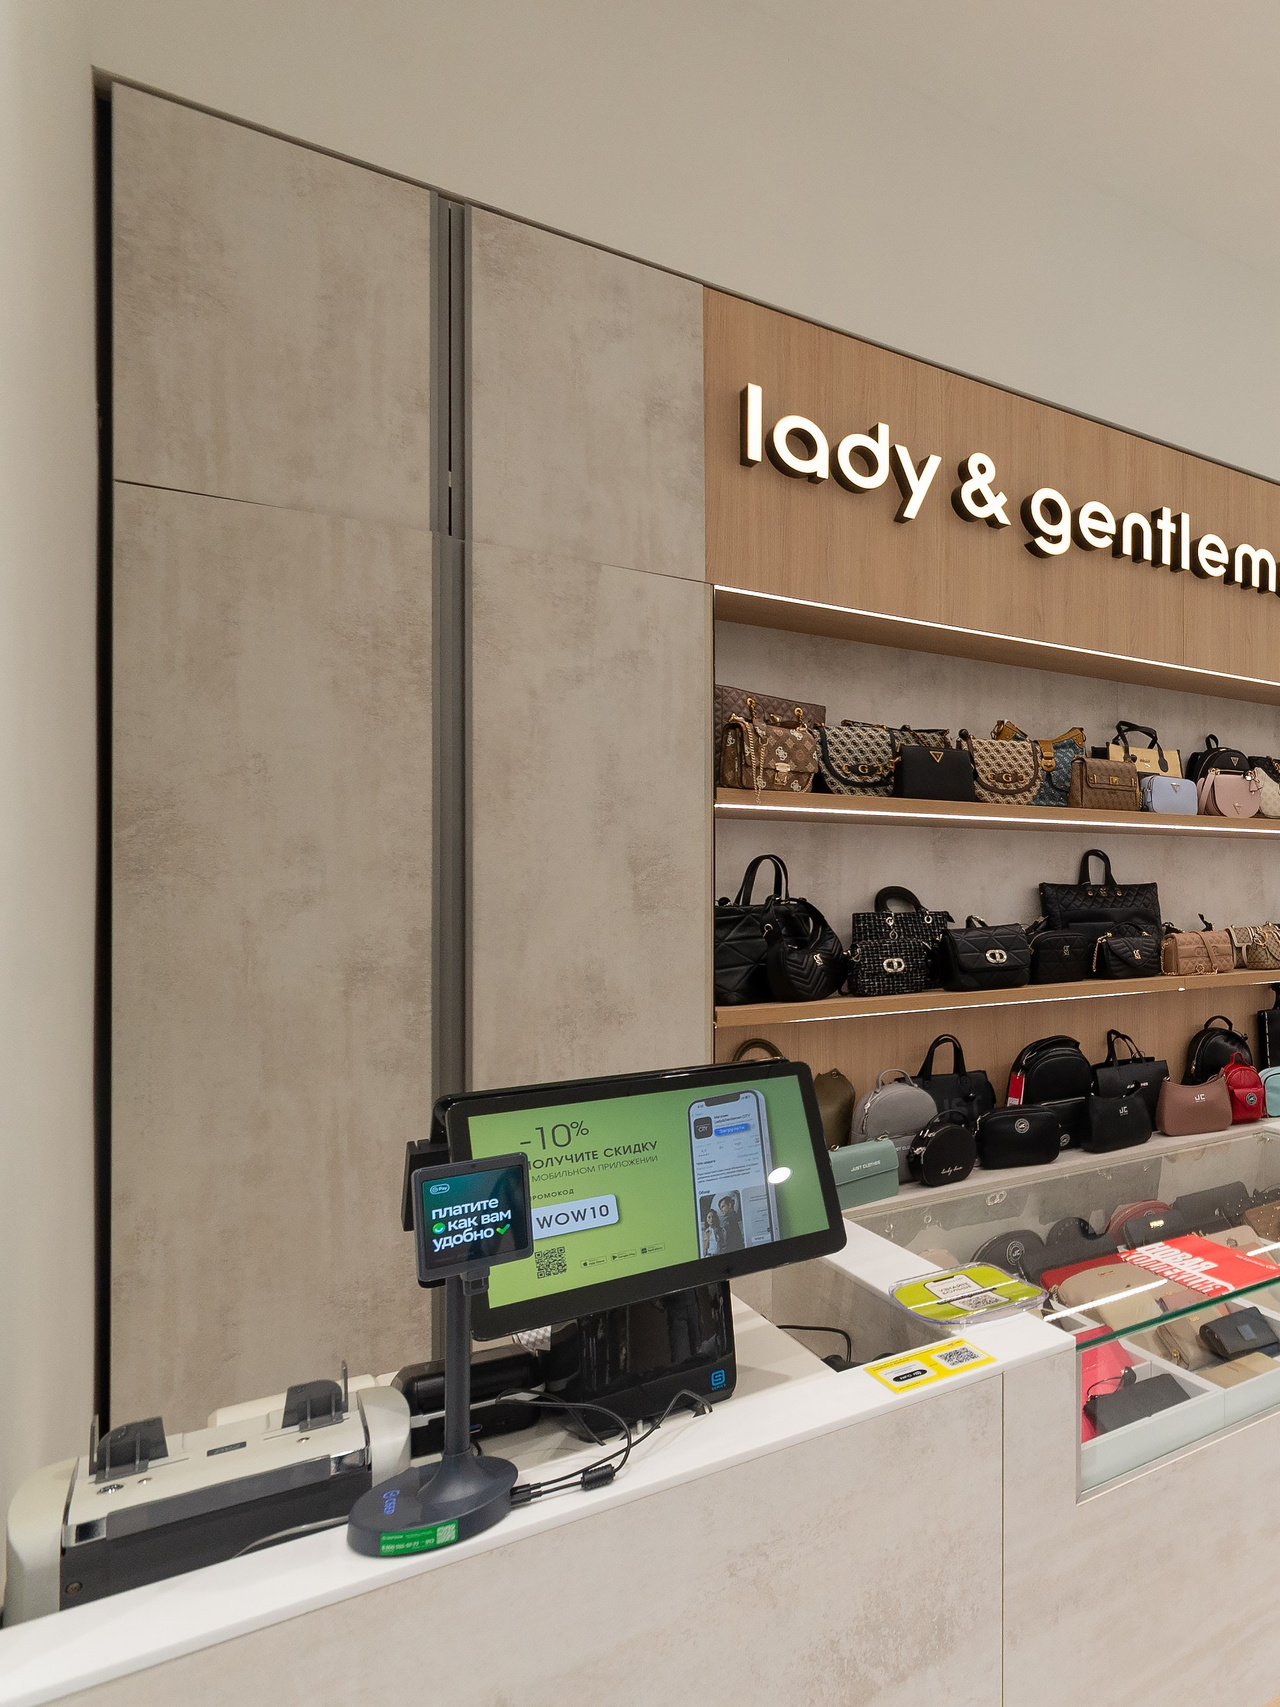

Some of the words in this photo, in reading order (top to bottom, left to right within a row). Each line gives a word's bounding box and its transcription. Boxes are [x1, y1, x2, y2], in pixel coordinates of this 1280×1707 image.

[739, 382, 942, 522] lady
[951, 452, 1011, 529] &
[520, 1120, 590, 1150] -10%
[603, 1140, 658, 1158] СКИДКУ
[531, 1165, 596, 1182] МОБИЛЬНОМ
[598, 1155, 659, 1172] ПРИЛОЖЕНИИ
[530, 1188, 574, 1201] РОМОКОД
[431, 1198, 499, 1220] платите
[447, 1216, 479, 1232] как
[481, 1209, 512, 1225] вам
[536, 1204, 610, 1230] WOW10
[432, 1227, 495, 1253] удобно
[1136, 1241, 1219, 1274] НОВАЯ
